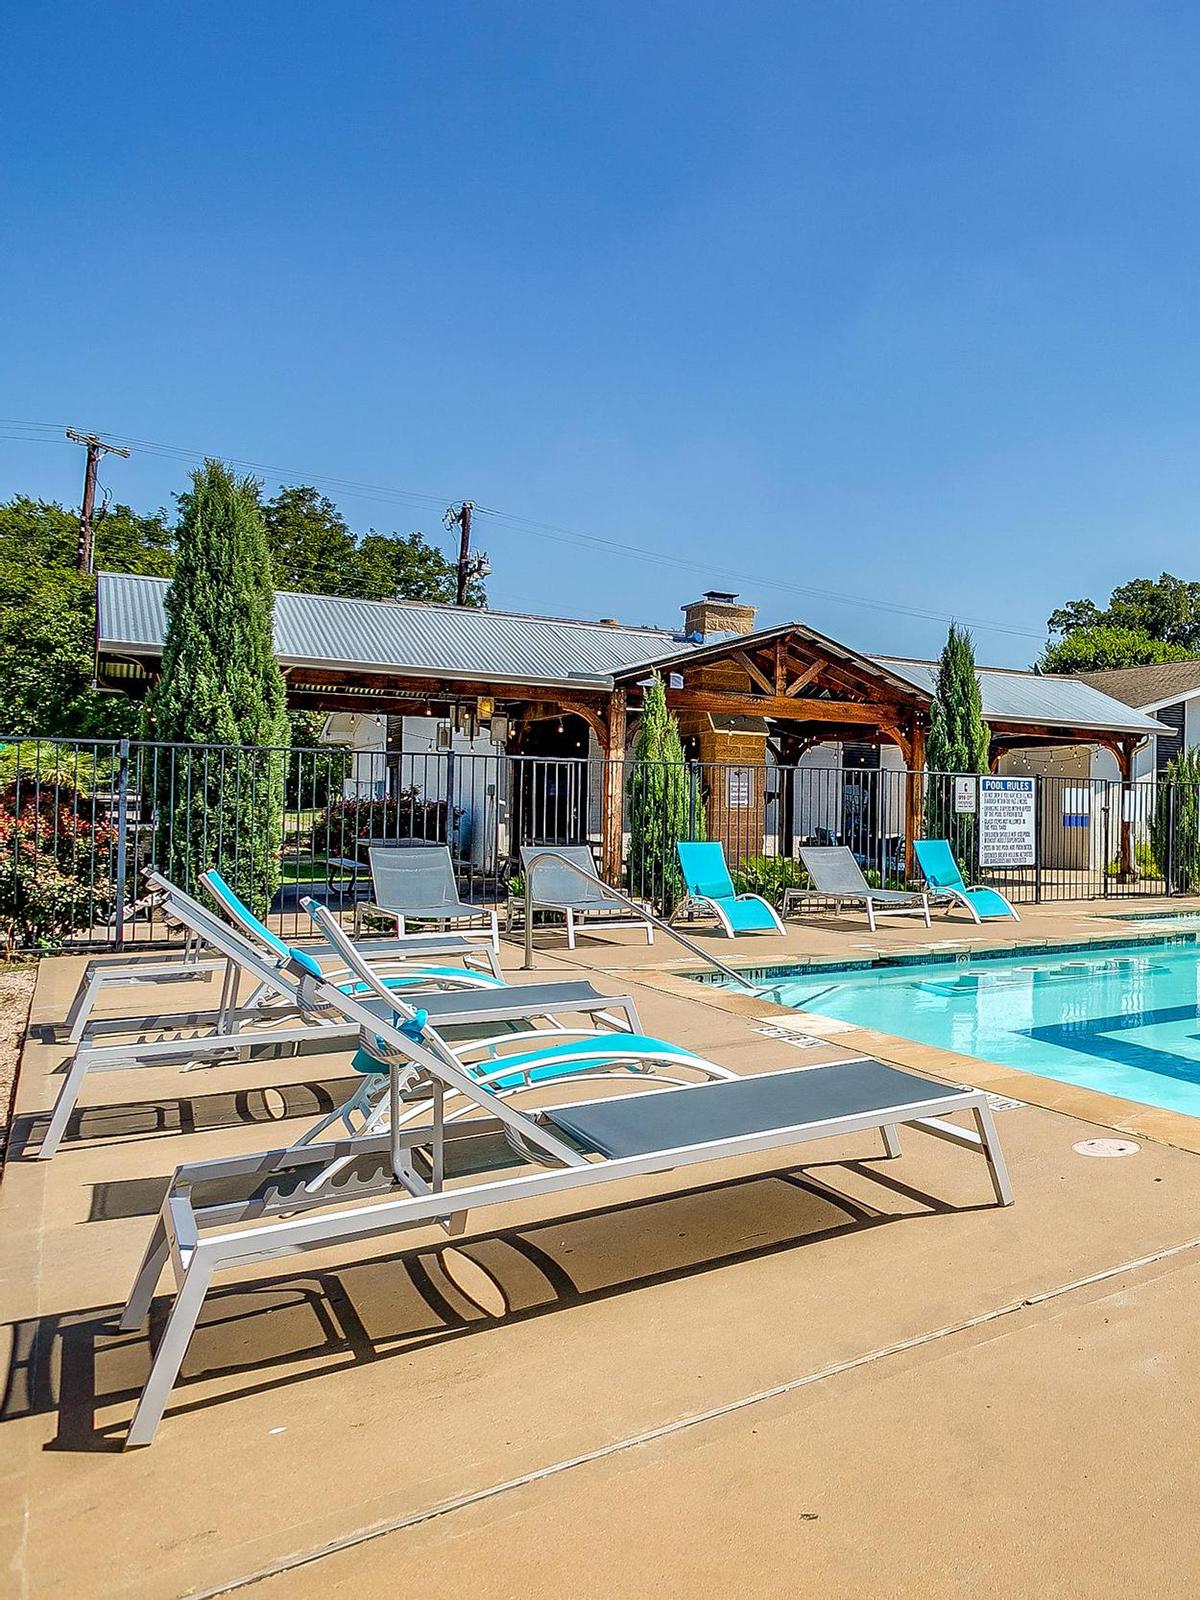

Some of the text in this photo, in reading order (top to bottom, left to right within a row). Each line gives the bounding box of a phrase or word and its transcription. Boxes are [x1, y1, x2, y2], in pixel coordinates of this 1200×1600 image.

[986, 781, 1029, 790] POOL RULES
[750, 969, 763, 980] IN
